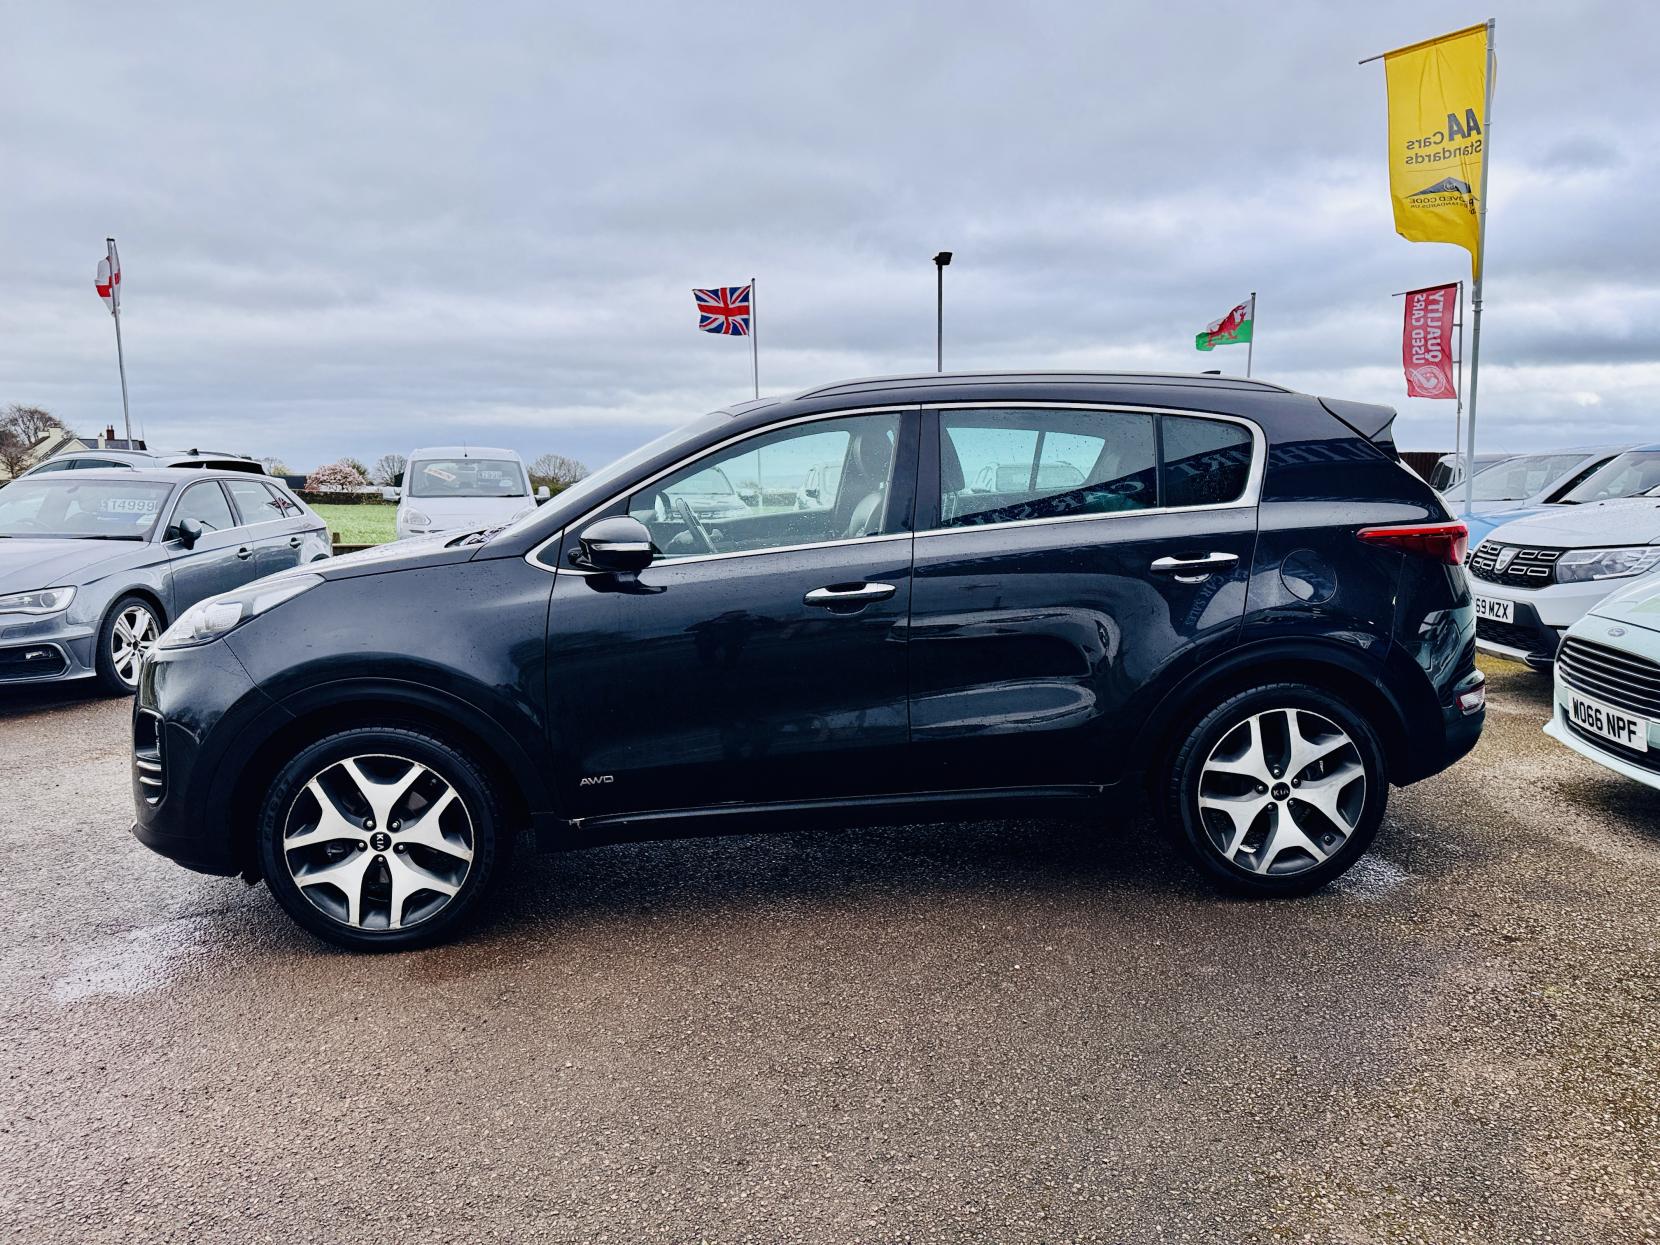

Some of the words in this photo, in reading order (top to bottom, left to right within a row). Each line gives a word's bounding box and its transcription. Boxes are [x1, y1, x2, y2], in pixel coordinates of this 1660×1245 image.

[1489, 601, 1508, 619] MZX
[1572, 697, 1603, 731] WO66
[1606, 712, 1637, 743] NPF
[580, 775, 614, 786] AWD
